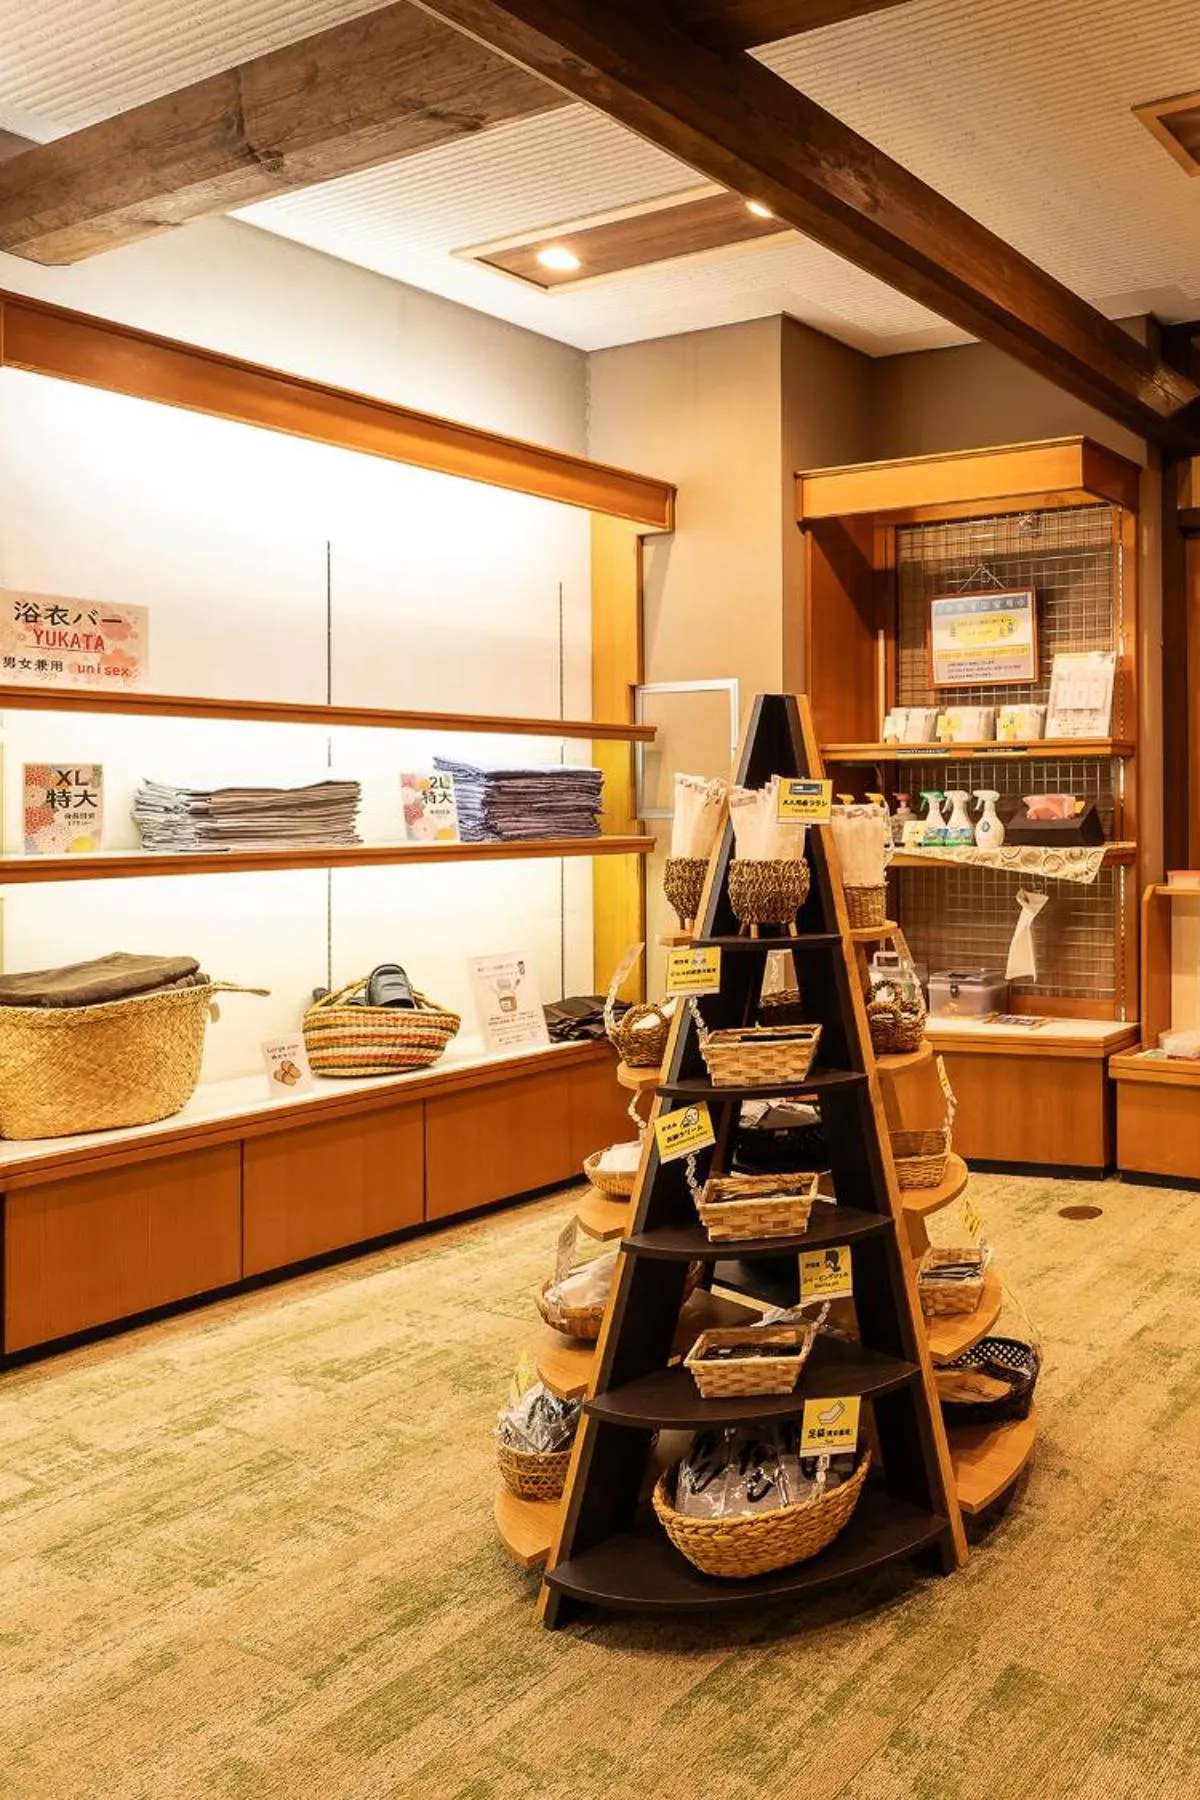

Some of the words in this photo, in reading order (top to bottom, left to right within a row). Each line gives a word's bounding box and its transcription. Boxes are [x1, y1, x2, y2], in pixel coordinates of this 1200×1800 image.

[14, 600, 122, 626] 浴衣バー
[32, 628, 105, 651] YUKATA
[3, 656, 63, 673] 男女兼用
[77, 661, 129, 677] unisex
[56, 769, 89, 786] XL
[429, 775, 450, 789] 2L
[46, 789, 98, 809] 特大
[422, 790, 453, 804] 特大
